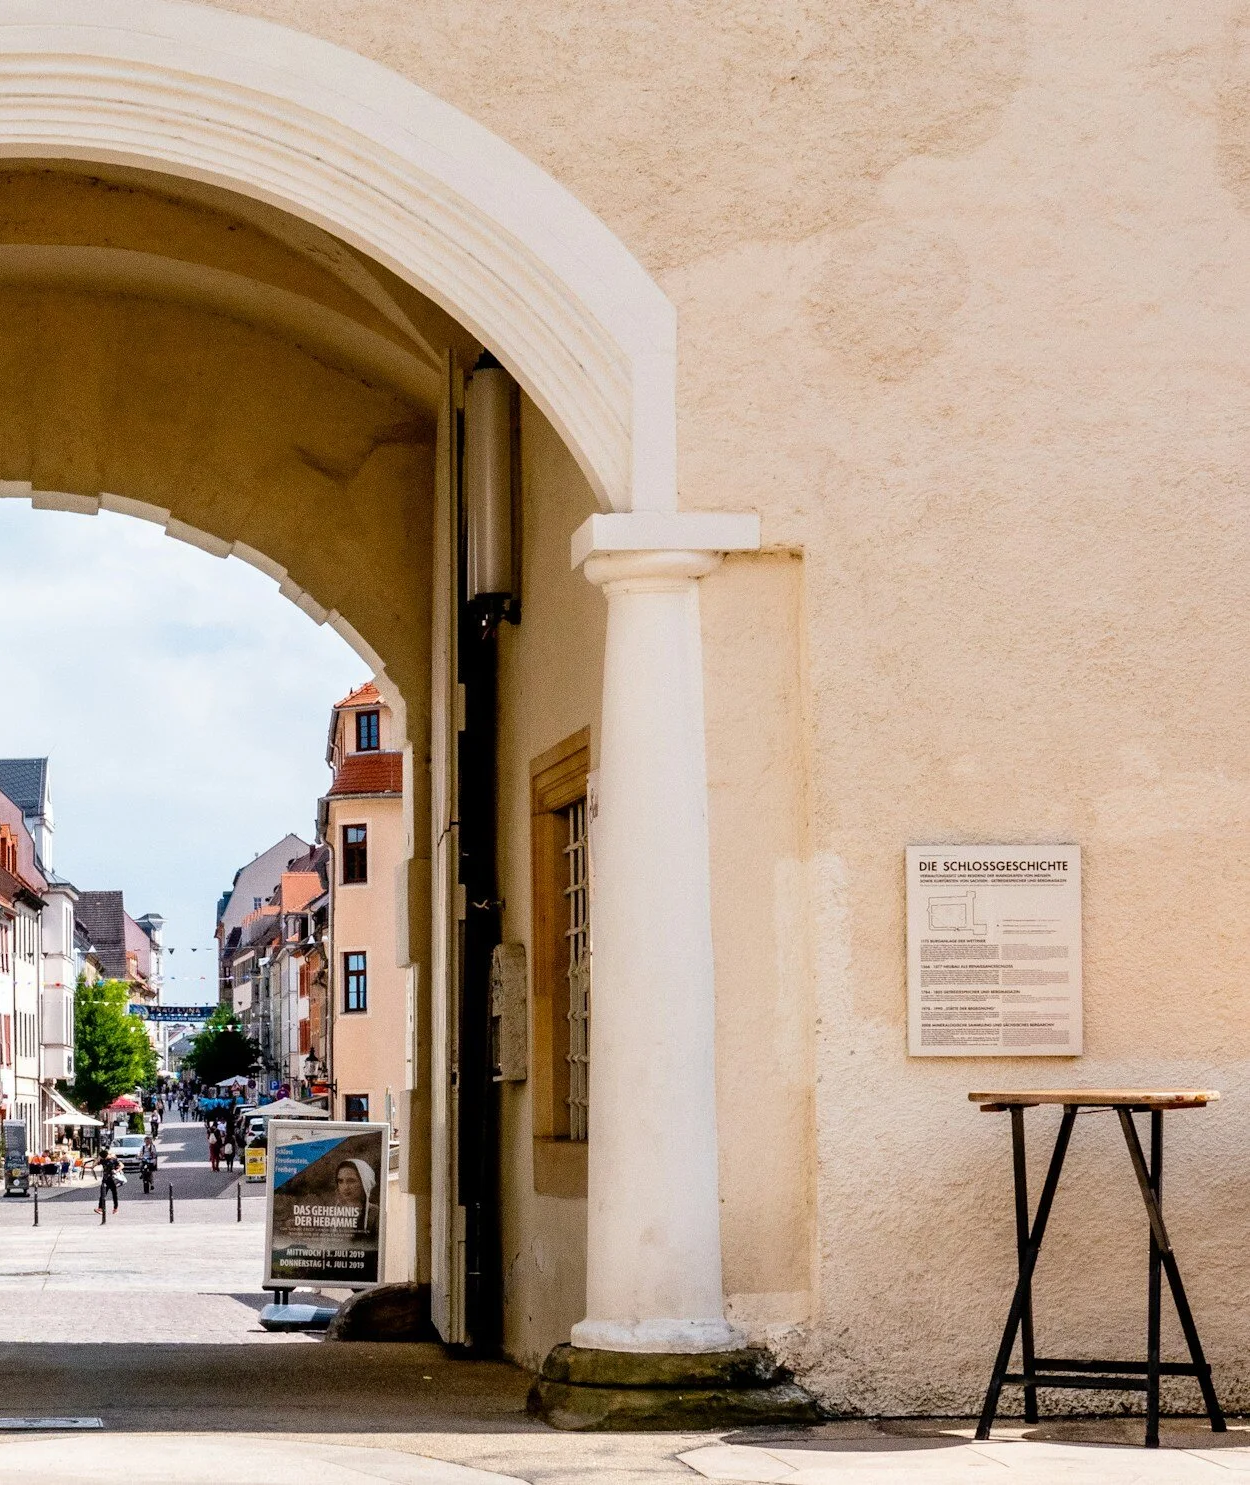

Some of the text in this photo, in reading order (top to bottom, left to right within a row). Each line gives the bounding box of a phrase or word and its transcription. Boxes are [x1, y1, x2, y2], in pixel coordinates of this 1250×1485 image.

[919, 861, 1069, 872] DIE SCHLOSSGESCHICHTE
[271, 1081, 278, 1089] P
[293, 1204, 360, 1217] DAS GEHEIMNIS
[294, 1216, 358, 1228] DER HEBAMME
[286, 1248, 322, 1257] MITTWOCH
[333, 1250, 348, 1258] JULI
[279, 1259, 322, 1267] DONNERSTAG
[326, 1260, 332, 1268] 4.
[348, 1261, 364, 1269] 2019
